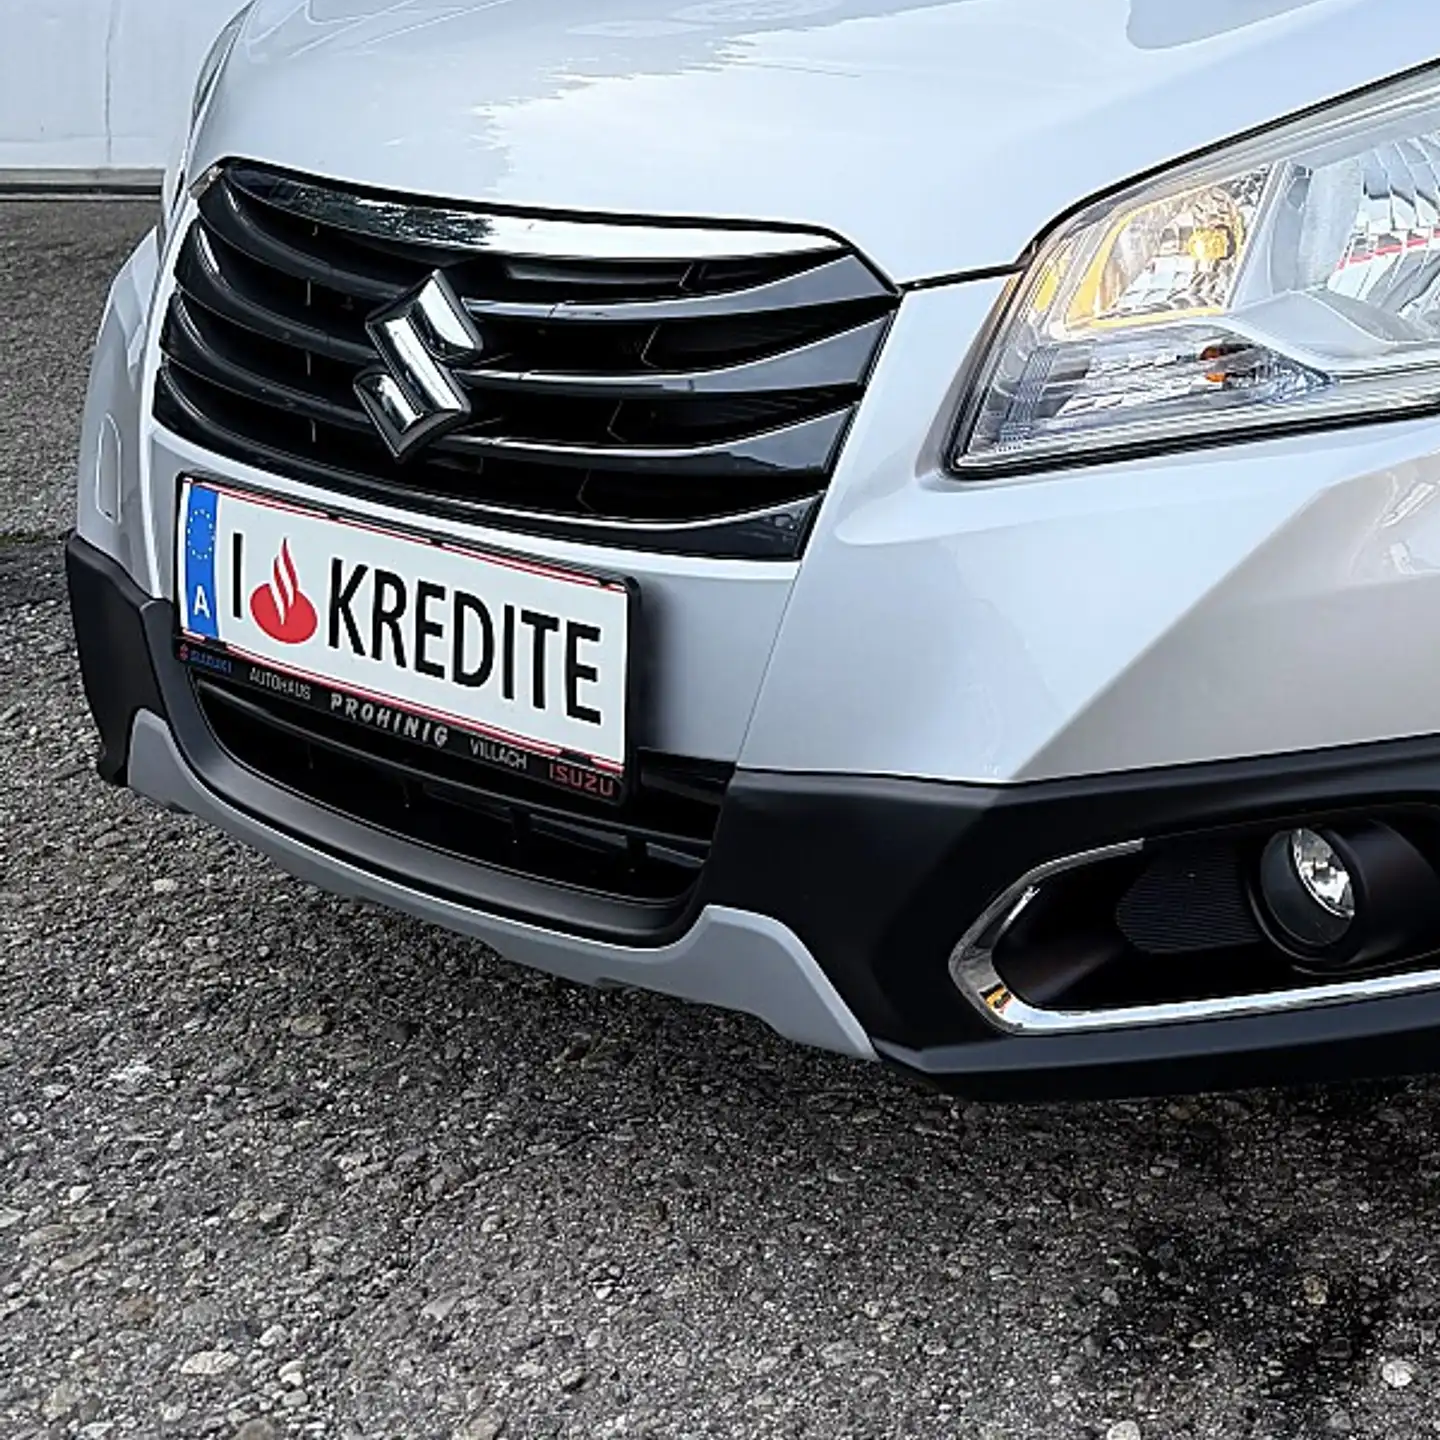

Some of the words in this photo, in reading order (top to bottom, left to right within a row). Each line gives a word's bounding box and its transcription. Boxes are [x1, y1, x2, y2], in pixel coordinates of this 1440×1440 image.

[193, 585, 210, 619] A
[233, 532, 243, 618] I
[328, 557, 601, 726] KREDITE
[249, 667, 312, 701] AUTOHAUS
[330, 692, 450, 748] PROHINIG
[470, 738, 528, 770] VILLACH
[550, 762, 614, 796] ISUZU
